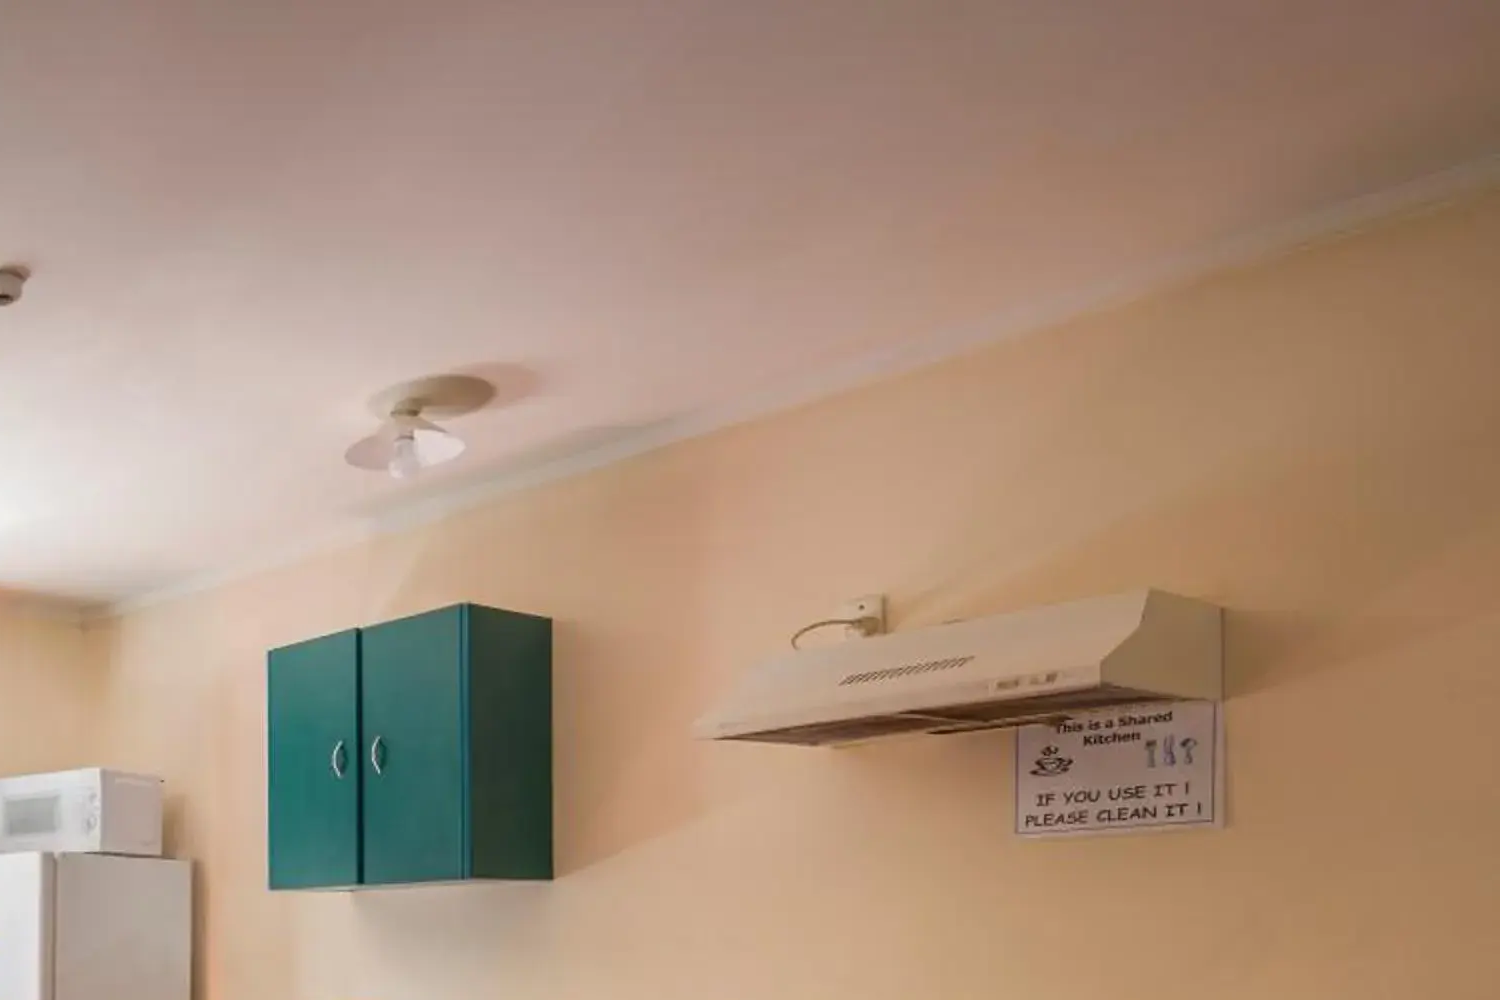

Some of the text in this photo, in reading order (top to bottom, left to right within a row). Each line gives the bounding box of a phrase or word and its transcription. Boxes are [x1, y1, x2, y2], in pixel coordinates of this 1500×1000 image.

[1088, 718, 1101, 731] is
[1105, 719, 1114, 729] a
[1119, 711, 1173, 727] Shared
[1083, 731, 1141, 746] Kitchen
[1036, 793, 1057, 807] IF
[1063, 789, 1101, 805] YOU
[1108, 785, 1147, 801] USE
[1153, 783, 1177, 797] IT
[1025, 810, 1089, 828] PLEASE
[1096, 806, 1158, 823] CLEAN
[1164, 803, 1189, 818] IT
